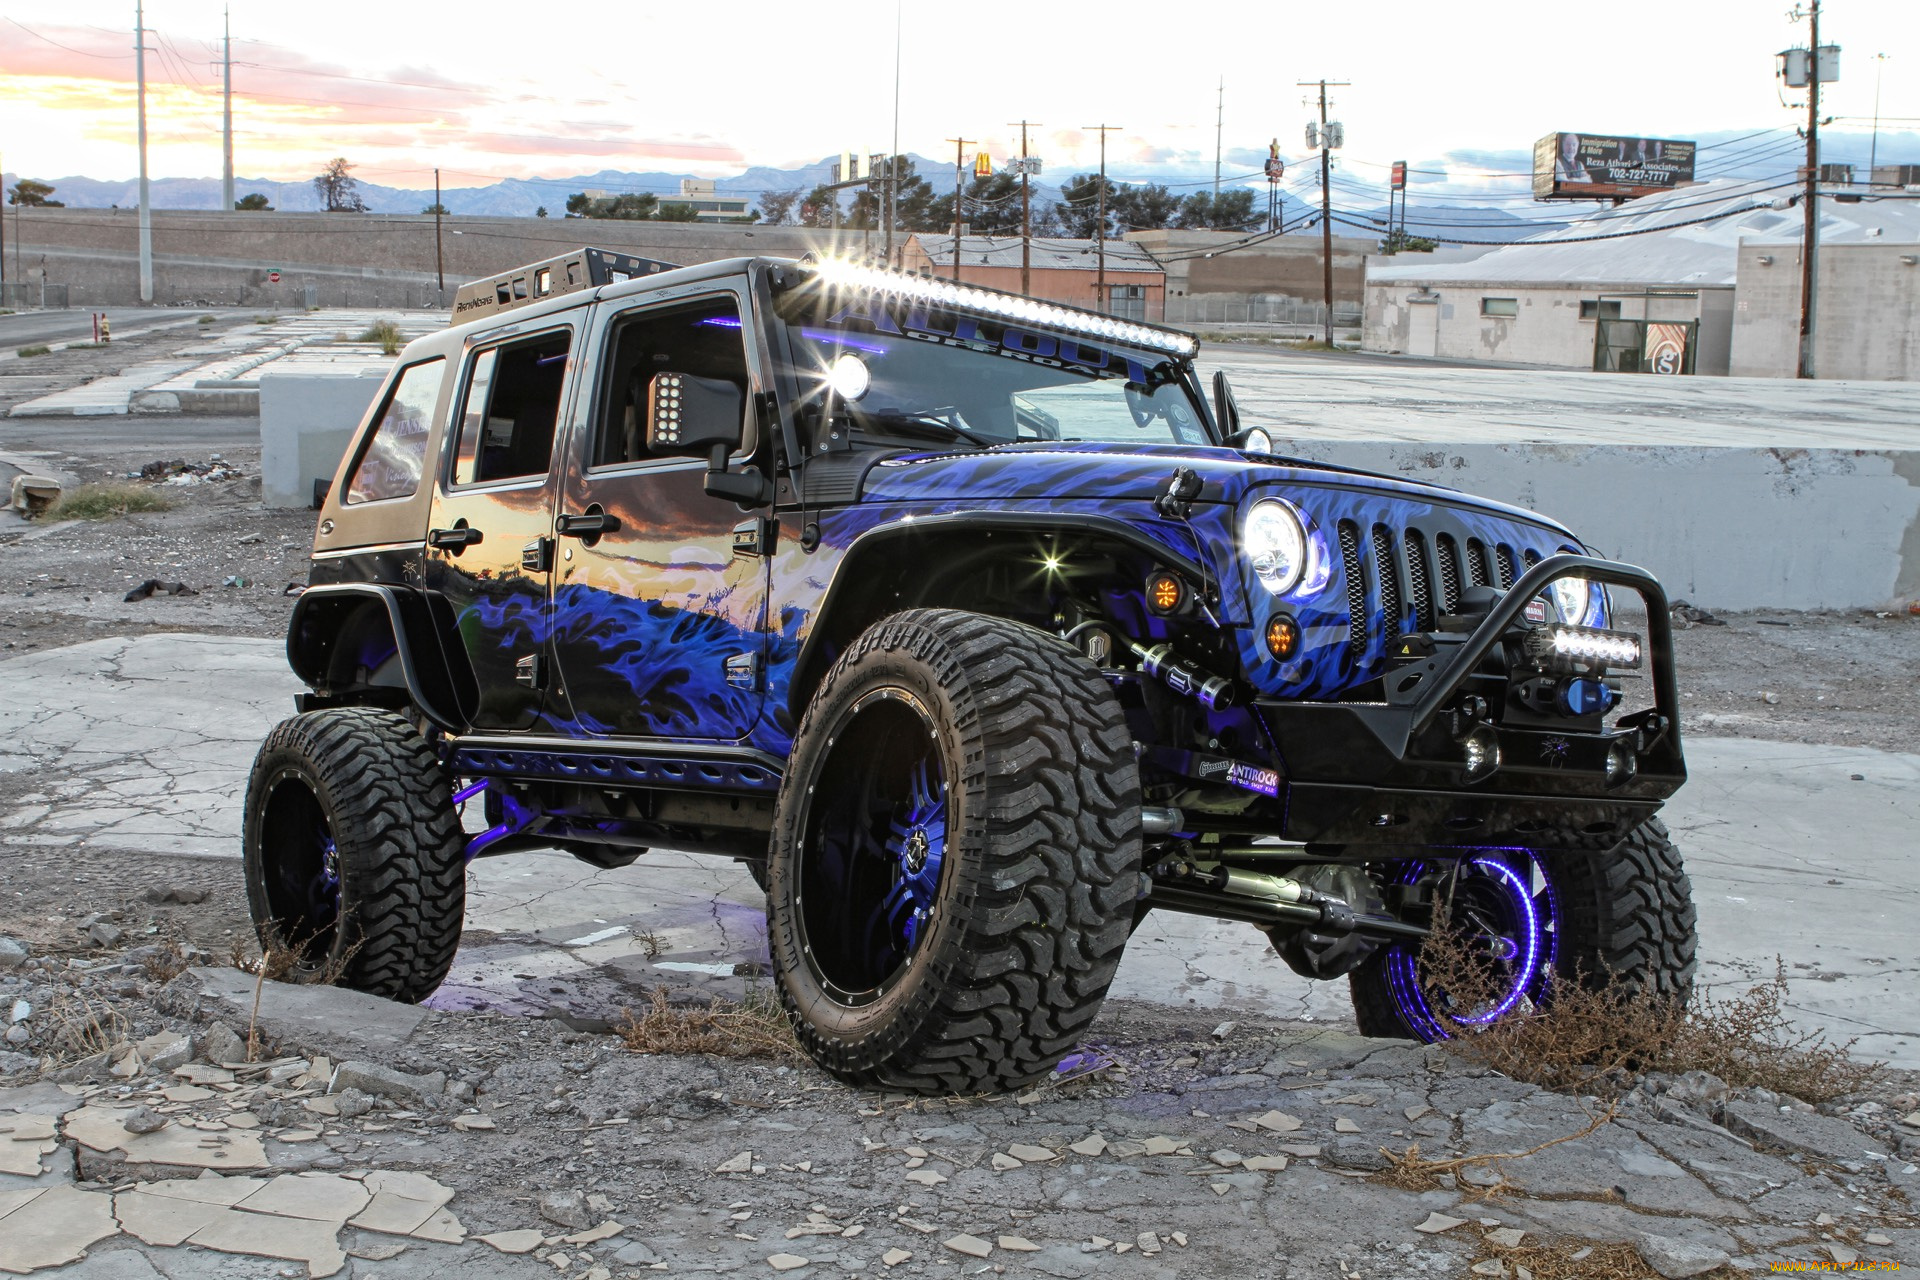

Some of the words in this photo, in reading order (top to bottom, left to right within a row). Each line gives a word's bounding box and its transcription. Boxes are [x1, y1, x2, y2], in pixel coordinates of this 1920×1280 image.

[1581, 138, 1618, 148] Immigration
[1587, 146, 1603, 155] More
[1586, 157, 1605, 167] Reza
[1609, 168, 1670, 181] 702-727-7777
